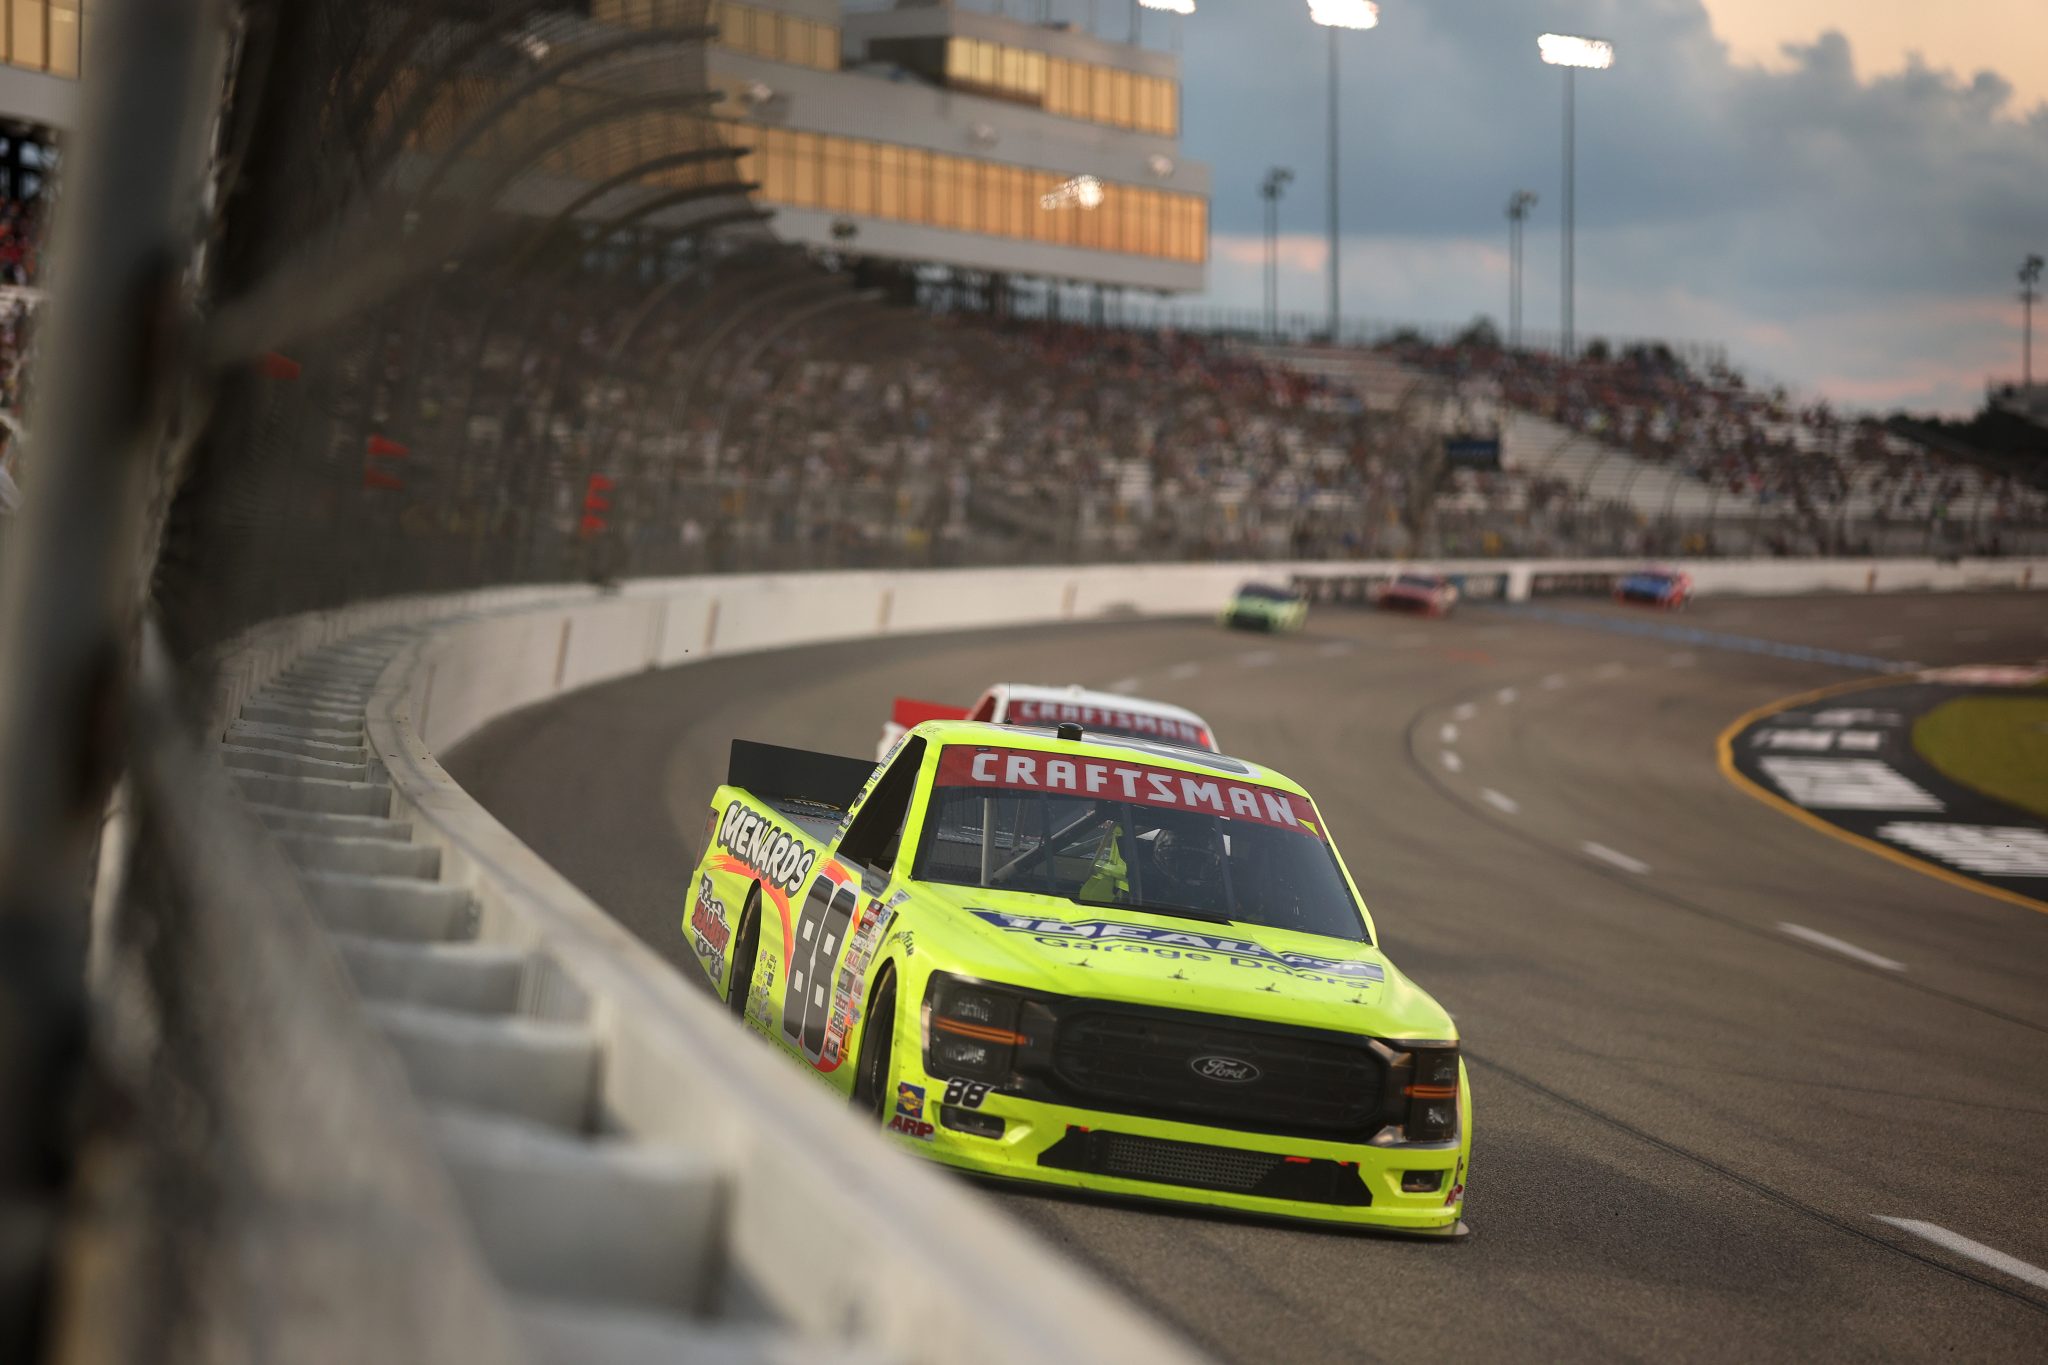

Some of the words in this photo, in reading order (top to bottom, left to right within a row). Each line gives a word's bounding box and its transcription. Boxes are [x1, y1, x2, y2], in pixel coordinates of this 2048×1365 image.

[1020, 703, 1197, 742] CRAFTSMAN
[971, 753, 1299, 827] CRAFTSMAN
[718, 801, 814, 895] MENARDS
[1000, 913, 1266, 956] IDEAL
[783, 874, 859, 1062] 88
[1035, 936, 1210, 961] Garage
[1230, 957, 1370, 989] Doors
[1202, 1058, 1249, 1080] Ford
[944, 1077, 993, 1109] 88
[889, 1114, 935, 1140] ARP
